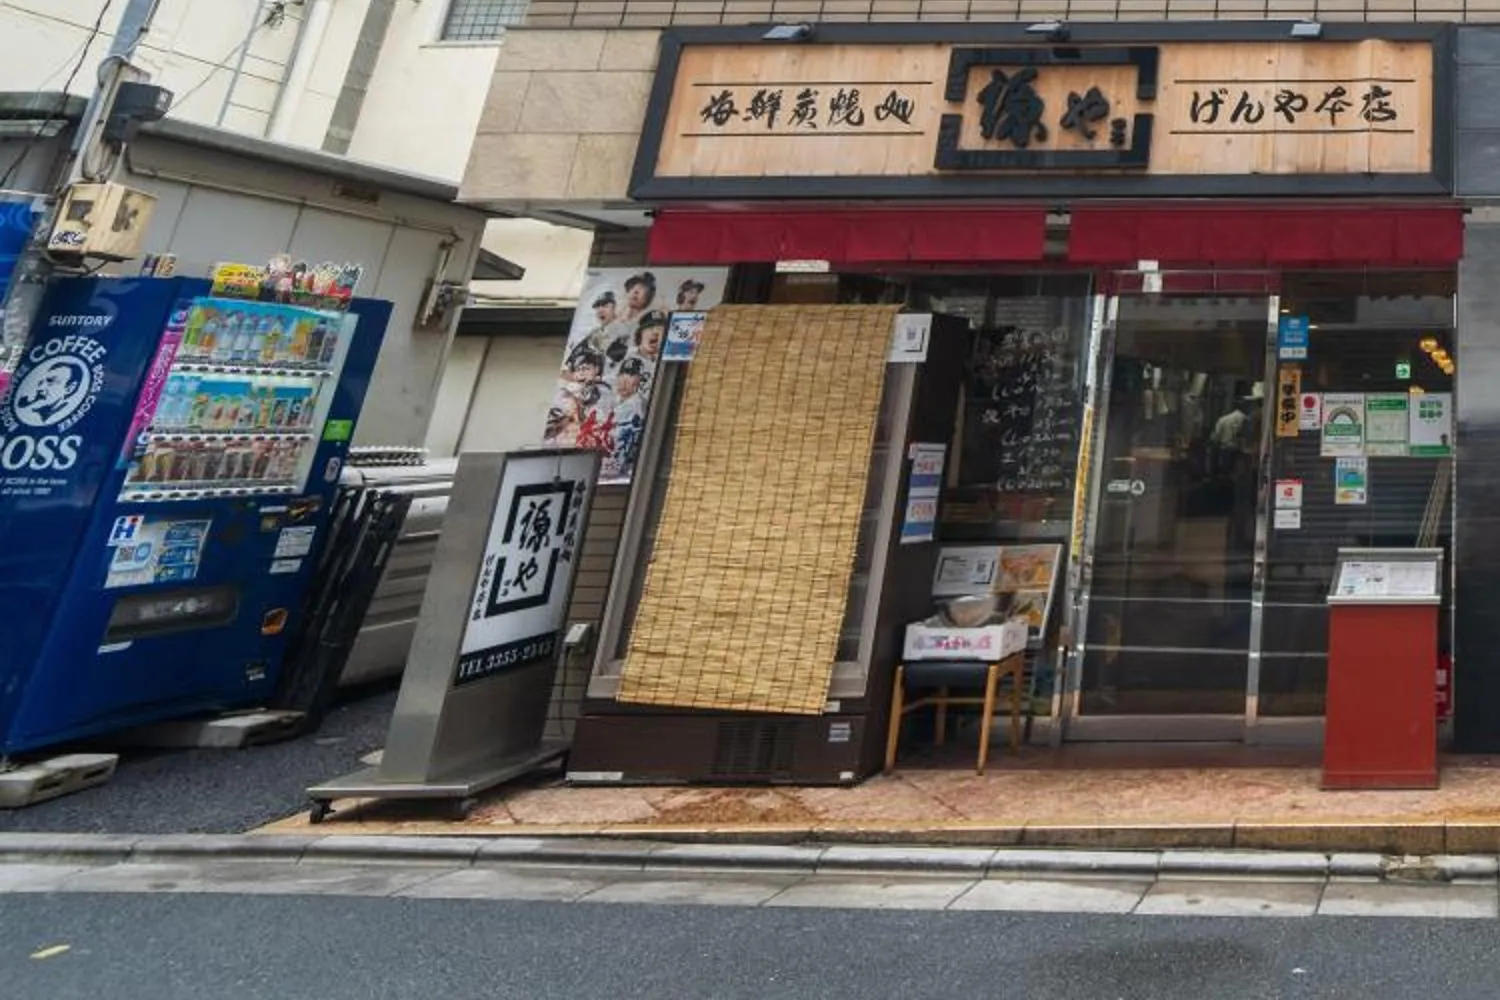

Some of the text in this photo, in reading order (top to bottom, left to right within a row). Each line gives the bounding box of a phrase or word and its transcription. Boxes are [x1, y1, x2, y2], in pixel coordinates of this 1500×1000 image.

[1188, 84, 1399, 127] げんや本店
[49, 314, 113, 327] SUNTORY
[29, 335, 108, 364] COFFEE
[0, 434, 83, 471] OSS
[459, 658, 483, 679] TEL
